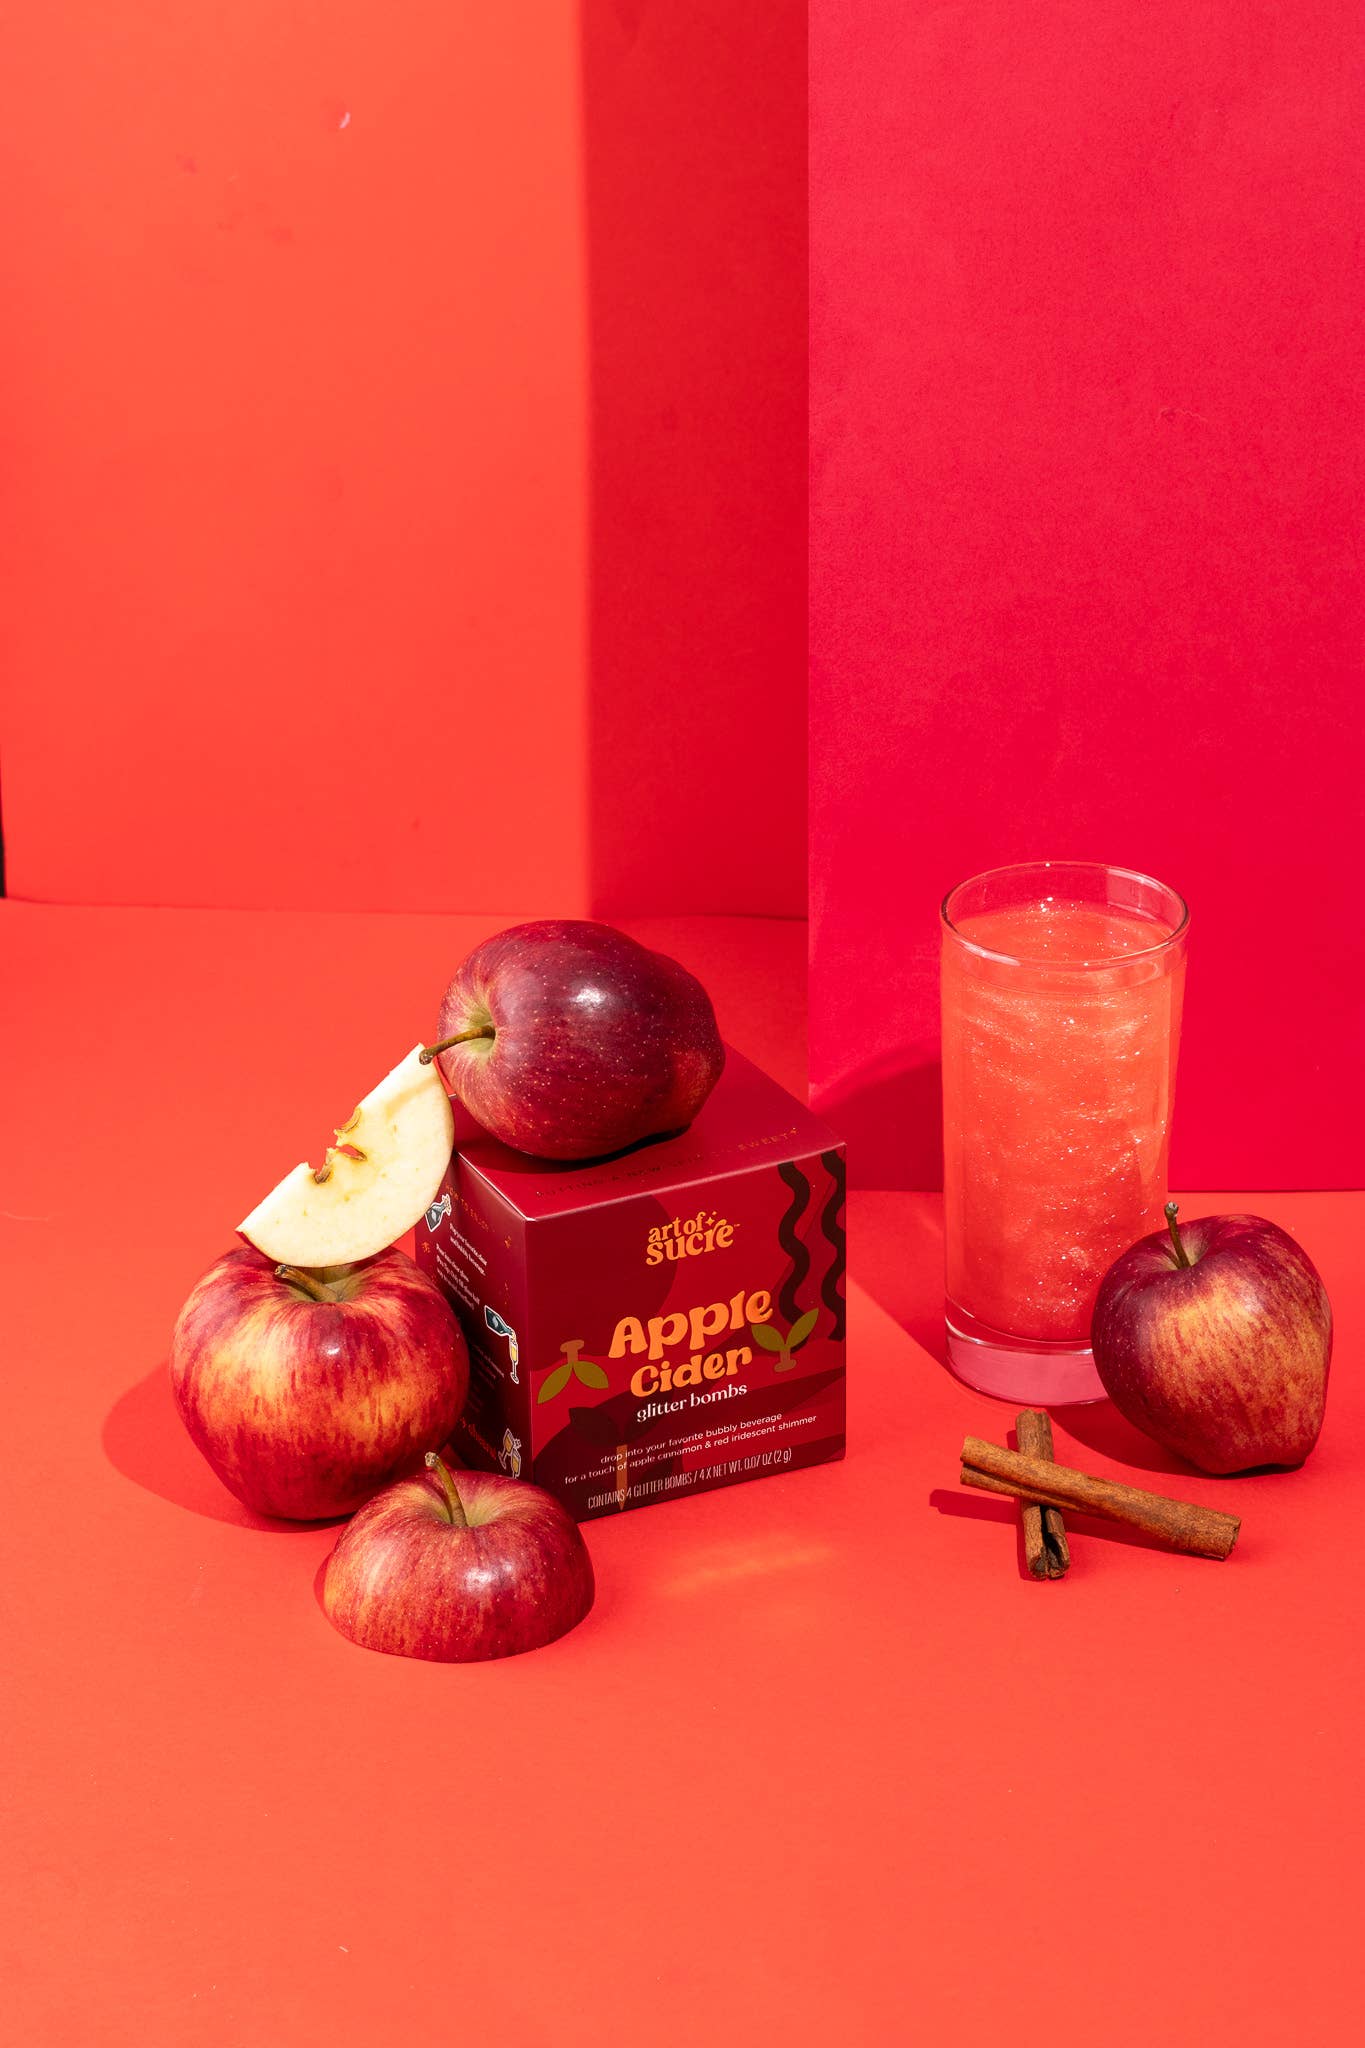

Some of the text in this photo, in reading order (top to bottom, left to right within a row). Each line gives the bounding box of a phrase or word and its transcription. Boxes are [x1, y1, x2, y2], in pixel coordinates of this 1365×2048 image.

[646, 1219, 734, 1266] sucre
[648, 1211, 706, 1243] art of
[608, 1290, 774, 1361] Apple
[630, 1346, 753, 1398] Cider
[636, 1383, 748, 1423] glitter bombs
[564, 1476, 578, 1485] for
[588, 1465, 615, 1478] touch
[617, 1461, 628, 1471] of
[629, 1455, 656, 1468] apple
[657, 1442, 703, 1460] cinnamon
[704, 1440, 712, 1449] &
[714, 1436, 729, 1447] red
[731, 1425, 776, 1442] iridescent
[778, 1415, 817, 1431] shimmer
[600, 1413, 783, 1464] drop into your favorite bubbly beverage
[588, 1489, 625, 1509] CONTAINS
[626, 1487, 632, 1499] 4
[633, 1479, 664, 1497] GLITTER
[664, 1472, 693, 1490] BOMBS
[699, 1468, 705, 1479] 4
[712, 1462, 727, 1478] NET
[744, 1455, 761, 1470] 0.07
[762, 1453, 773, 1466] OZ
